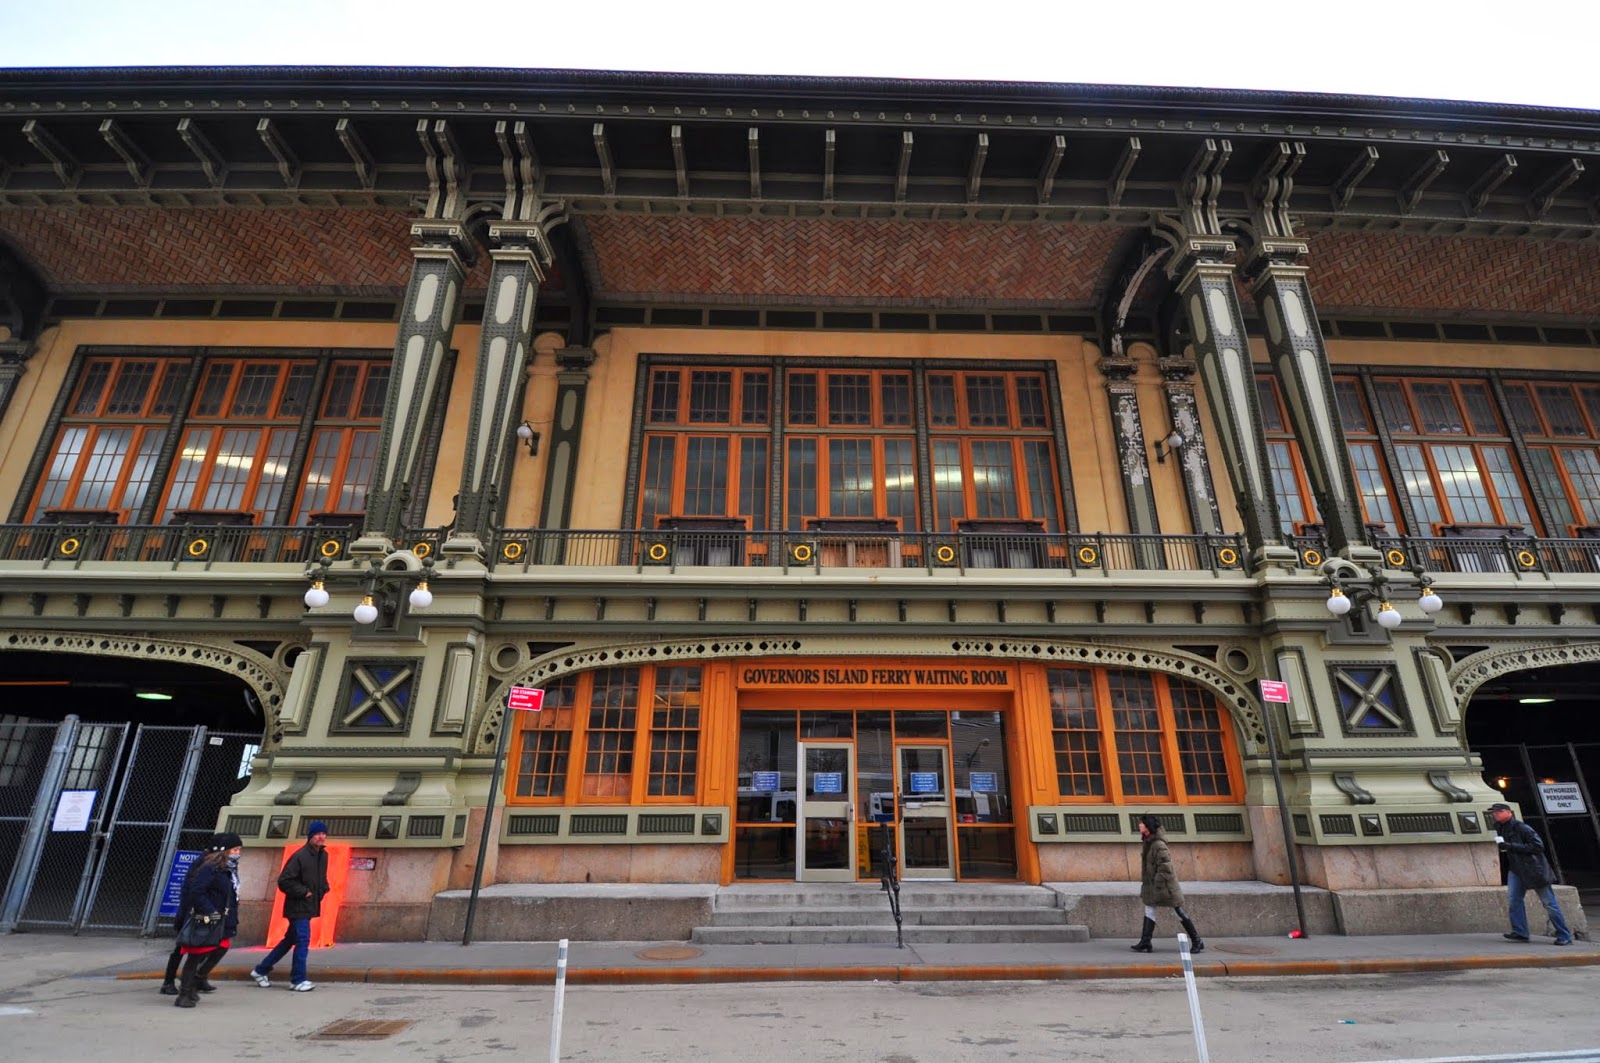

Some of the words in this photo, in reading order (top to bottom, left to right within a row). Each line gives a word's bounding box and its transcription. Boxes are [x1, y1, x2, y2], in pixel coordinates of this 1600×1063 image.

[743, 668, 820, 684] GOVERNORS
[823, 669, 869, 684] ISLAND
[871, 669, 912, 685] FERRY
[914, 669, 969, 685] WAITING
[970, 670, 1008, 685] ROOM
[179, 853, 201, 861] NOTI
